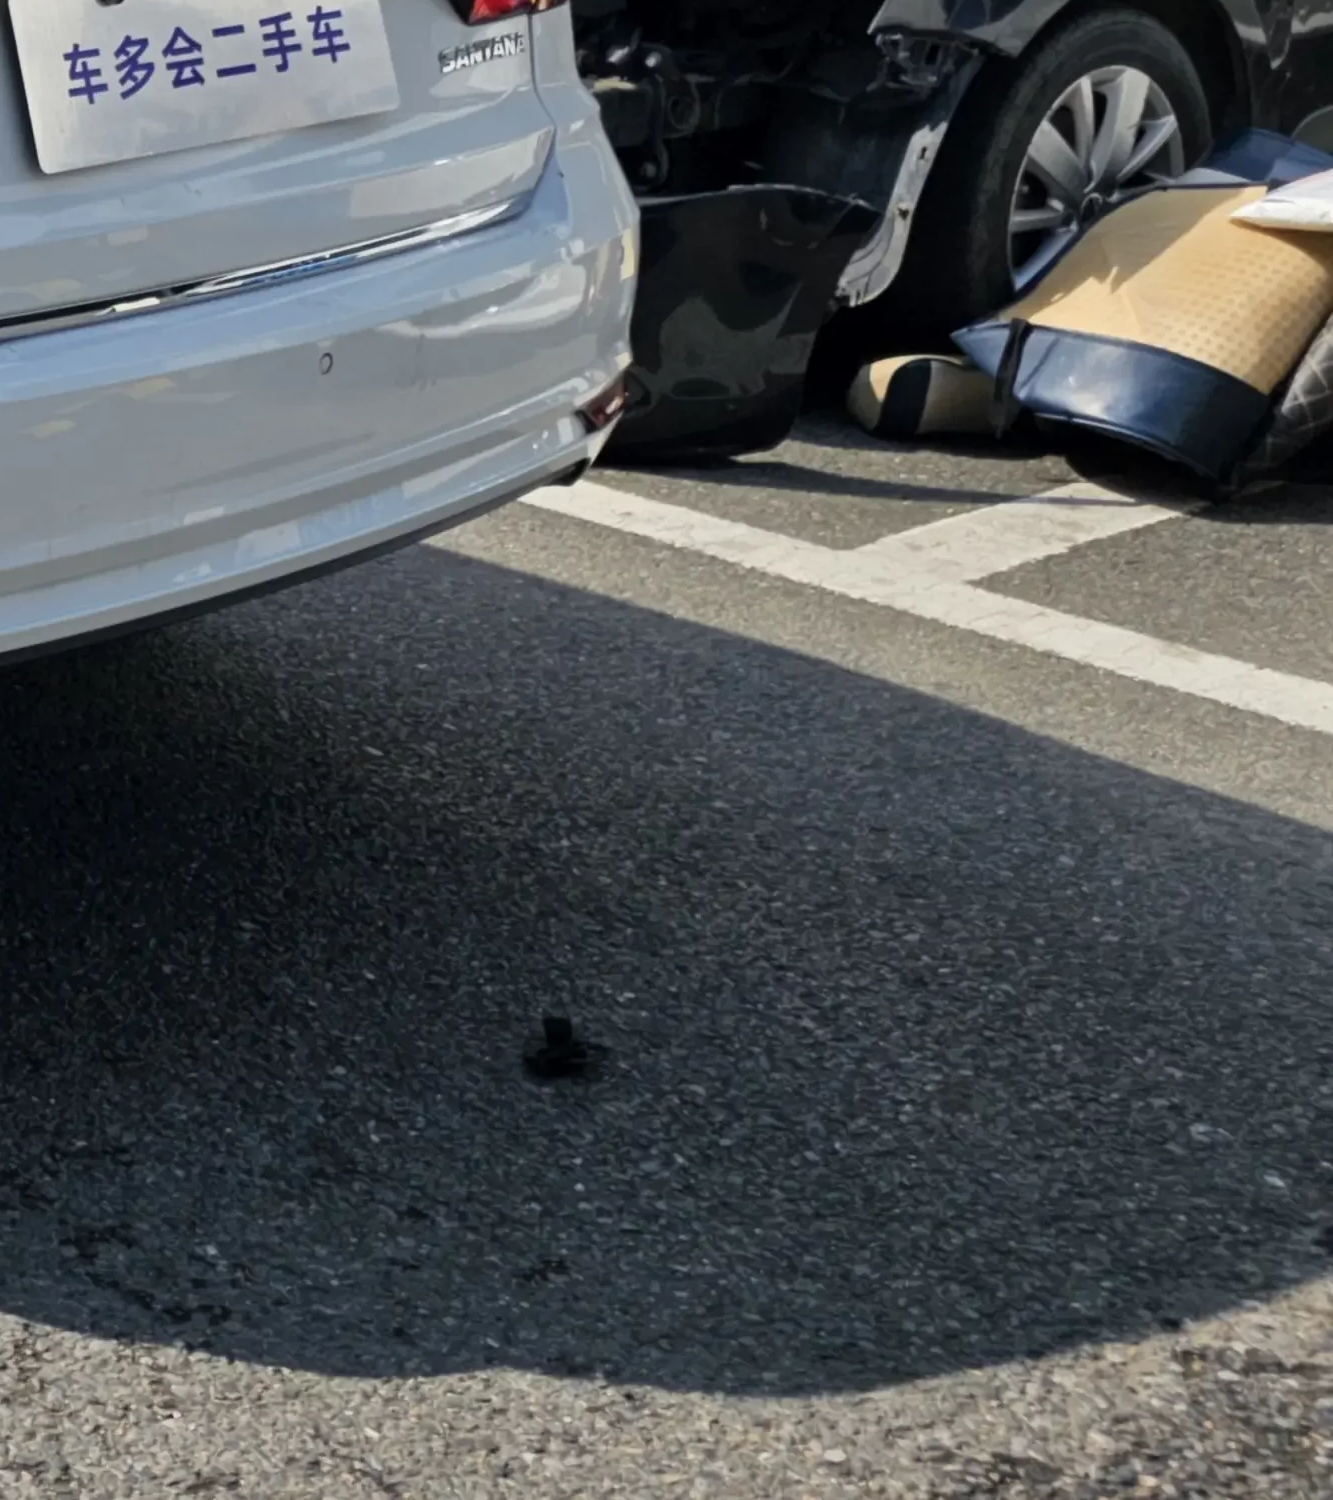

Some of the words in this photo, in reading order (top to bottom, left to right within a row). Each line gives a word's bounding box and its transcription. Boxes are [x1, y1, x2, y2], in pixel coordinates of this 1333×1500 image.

[63, 6, 351, 104] 车多会二手车
[438, 31, 526, 74] SANTANA
